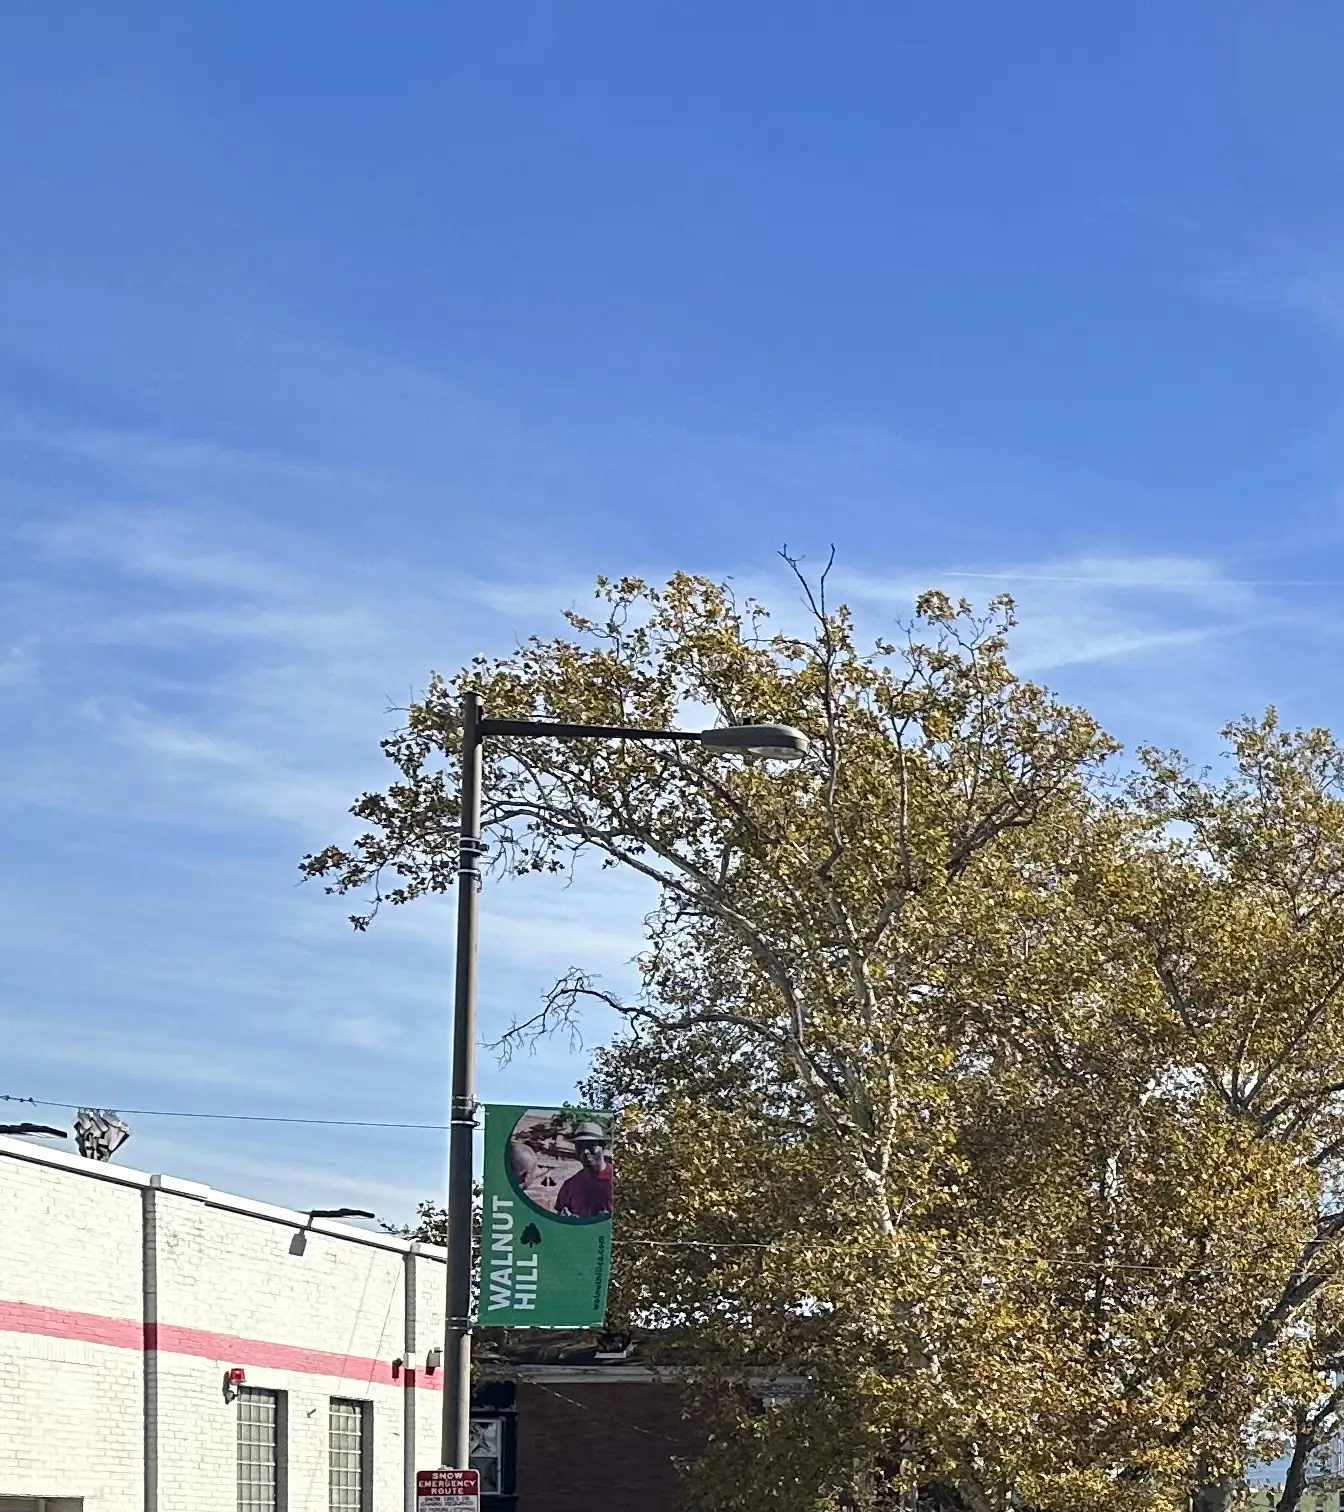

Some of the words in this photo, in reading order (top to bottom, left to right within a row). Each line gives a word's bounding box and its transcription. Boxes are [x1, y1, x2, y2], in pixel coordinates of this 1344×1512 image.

[488, 1195, 514, 1311] WALNUT
[513, 1253, 538, 1310] HILL
[431, 1472, 464, 1480] SNOW
[418, 1480, 476, 1488] EMERGENCY
[431, 1487, 465, 1495] ROUTE
